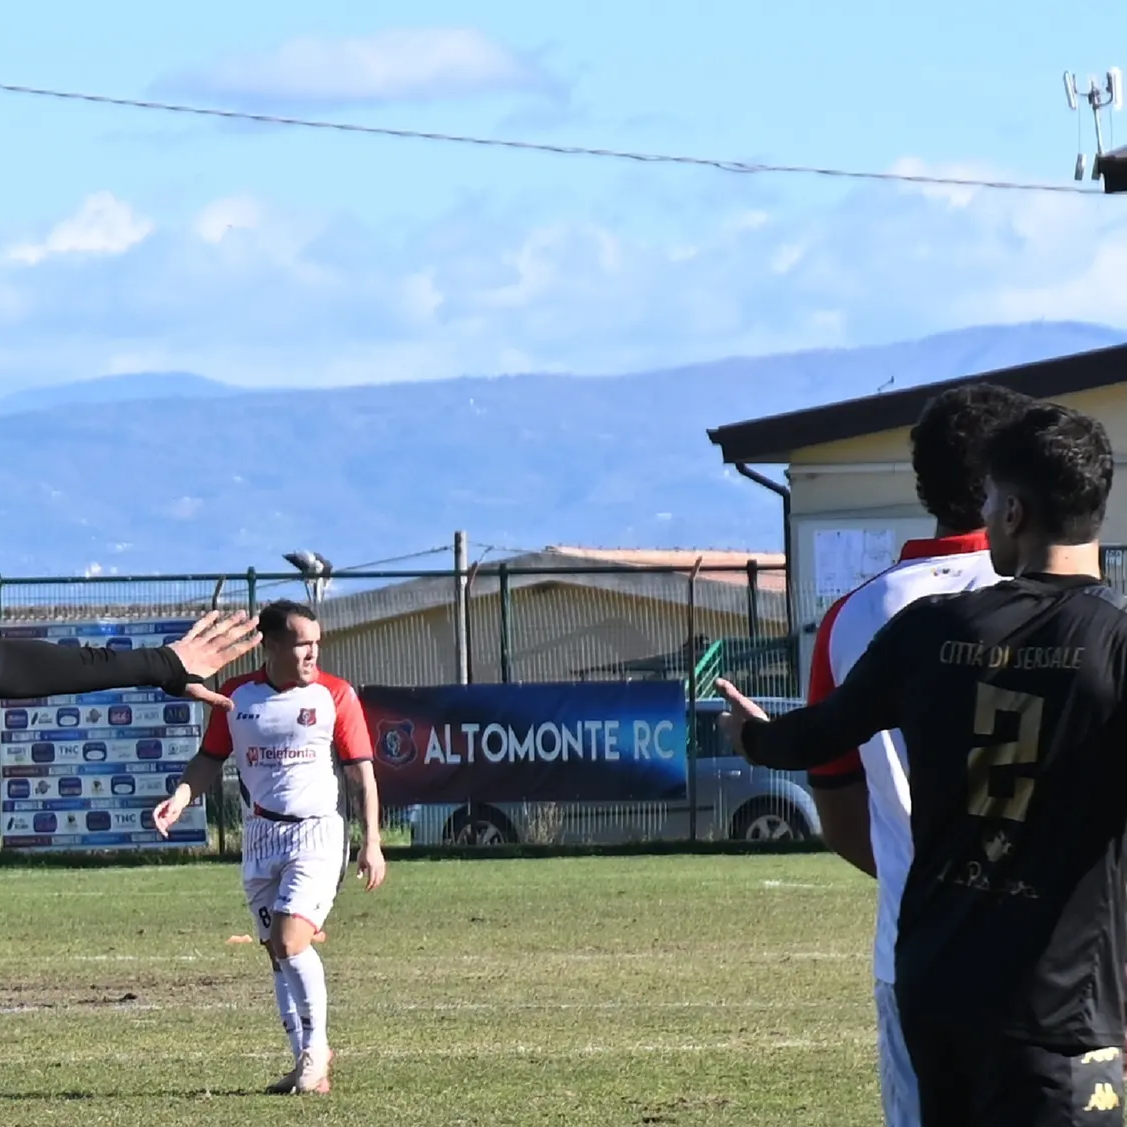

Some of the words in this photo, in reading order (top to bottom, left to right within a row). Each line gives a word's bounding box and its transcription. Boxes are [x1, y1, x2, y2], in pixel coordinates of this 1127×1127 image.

[988, 645, 1009, 668] DI
[424, 720, 620, 764] ALTOMONTE
[632, 719, 674, 760] RC
[967, 681, 1045, 822] 2
[259, 906, 271, 929] 8
